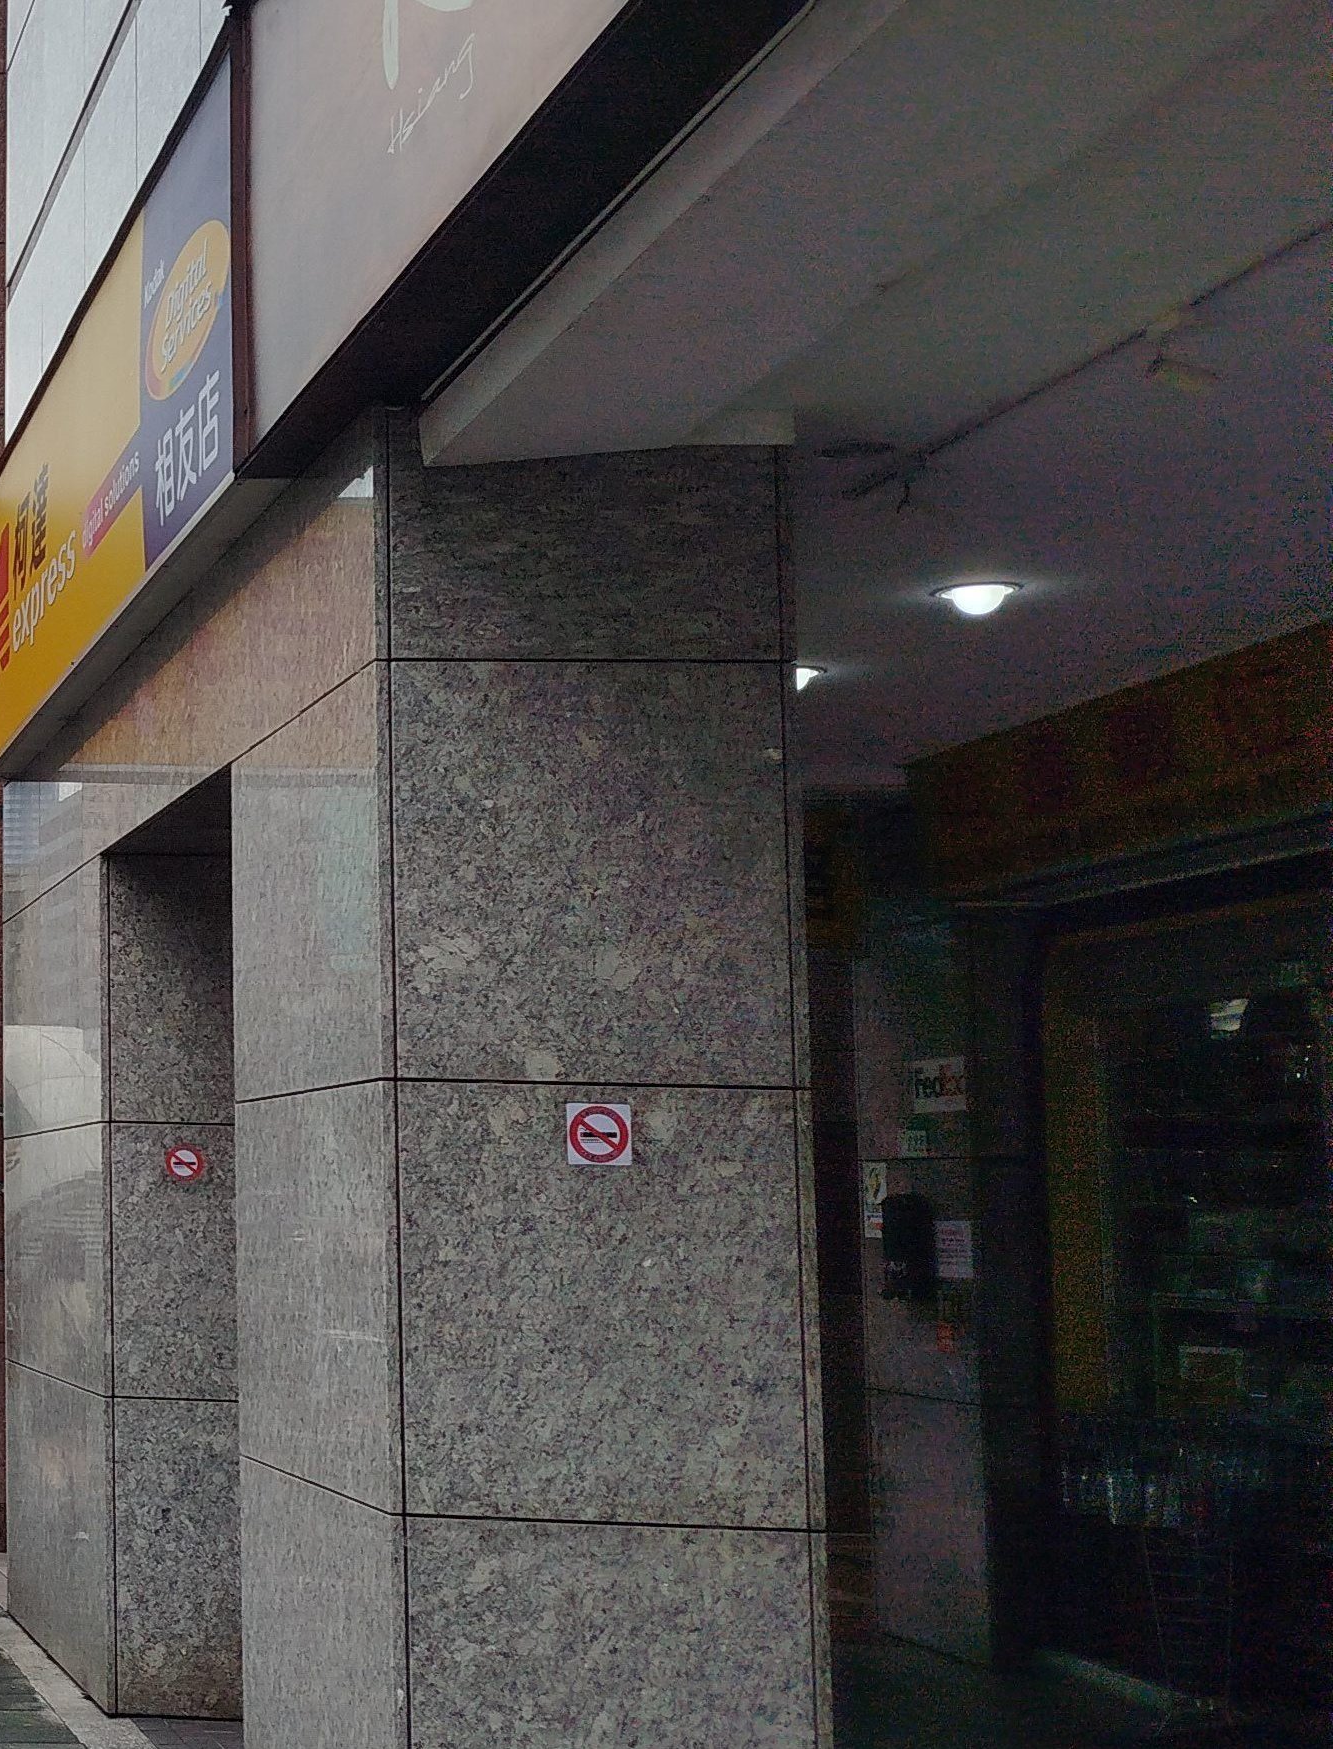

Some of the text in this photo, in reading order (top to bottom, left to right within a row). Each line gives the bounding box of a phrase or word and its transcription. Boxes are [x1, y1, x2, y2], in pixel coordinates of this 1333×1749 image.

[82, 451, 140, 549] digital solutions
[155, 369, 220, 526] 相友店
[12, 530, 77, 652] express
[13, 463, 49, 600] 柯達
